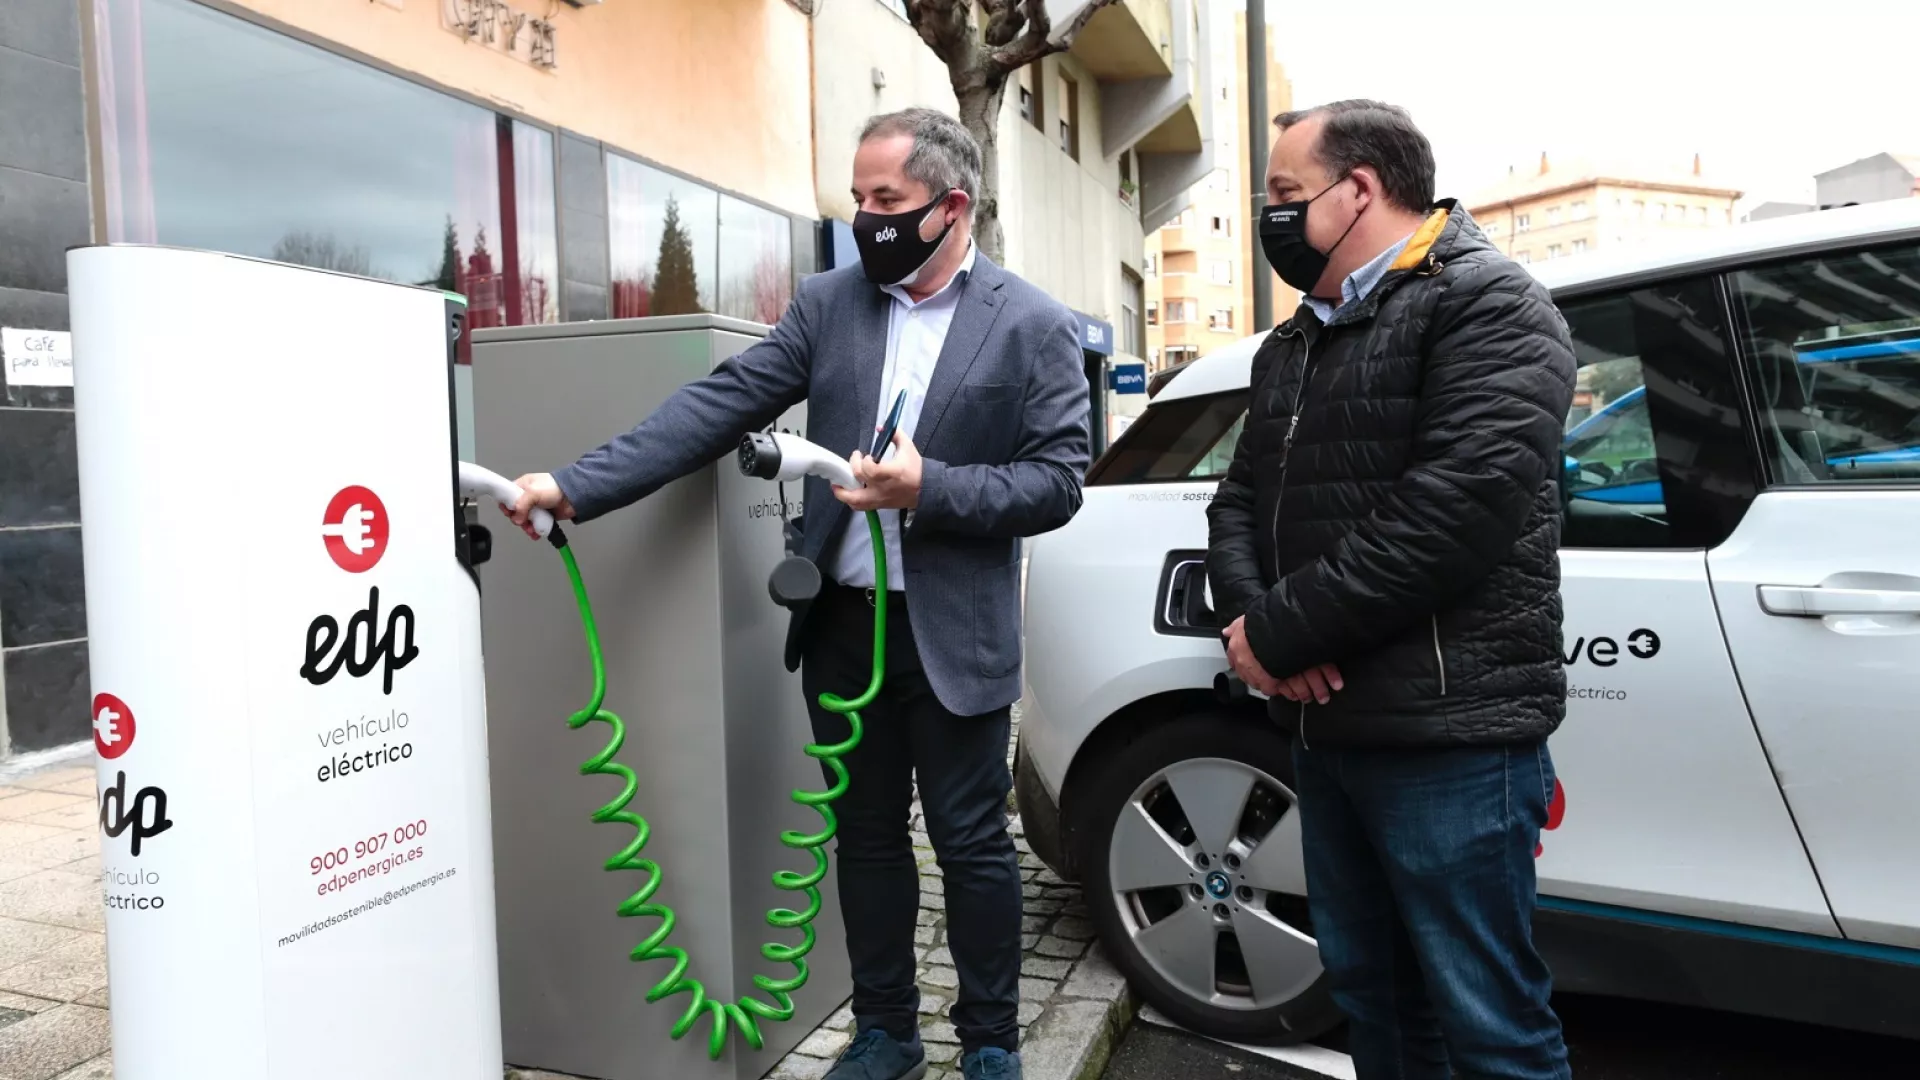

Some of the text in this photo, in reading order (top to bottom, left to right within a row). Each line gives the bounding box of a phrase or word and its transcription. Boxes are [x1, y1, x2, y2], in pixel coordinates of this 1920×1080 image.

[875, 226, 898, 243] edp
[1087, 324, 1105, 345] BBVA
[12, 355, 74, 373] para lleva
[1117, 374, 1144, 385] BBVA
[1182, 491, 1215, 502] soste
[300, 585, 420, 696] edp
[1567, 684, 1628, 701] éctrico
[317, 708, 410, 749] vehículo
[316, 740, 413, 783] eléctrico
[99, 769, 174, 858] dp
[310, 819, 427, 875] 900 907 000
[103, 866, 160, 886] hículo
[316, 845, 424, 897] edpenergia.es
[104, 889, 165, 911] éctrico
[277, 866, 457, 948] movilidadsostenible@edpenergia.es
